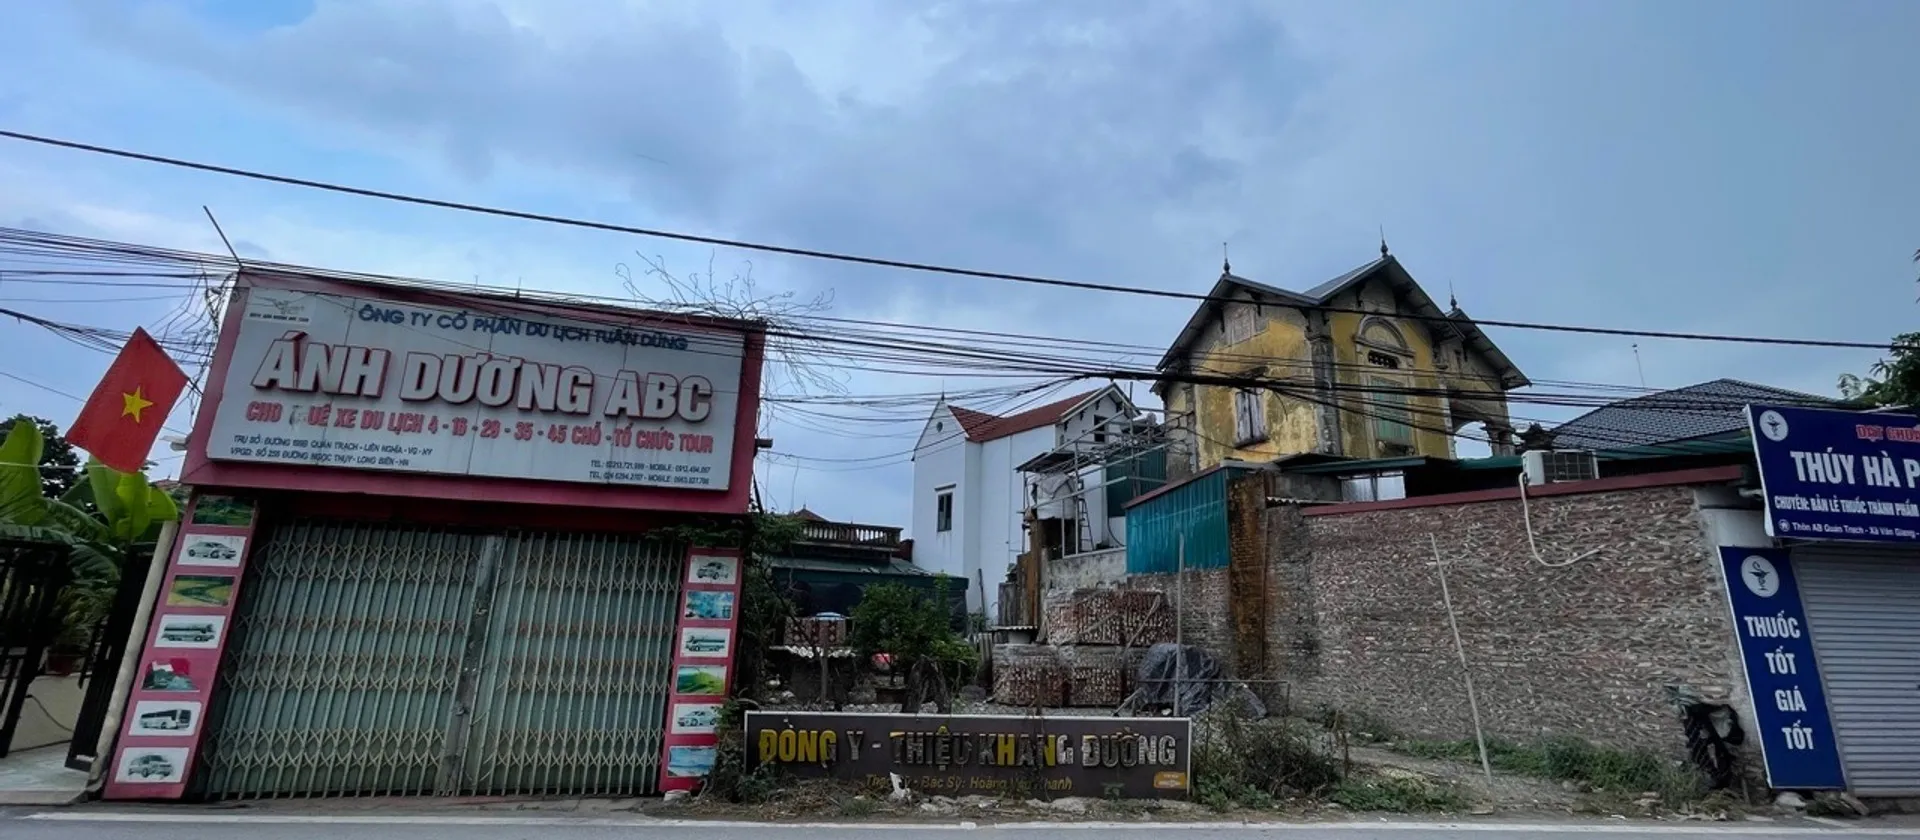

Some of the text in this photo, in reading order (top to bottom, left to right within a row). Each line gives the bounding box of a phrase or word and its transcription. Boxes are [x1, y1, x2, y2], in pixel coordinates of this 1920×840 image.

[411, 311, 433, 327] TY
[436, 310, 468, 330] CỔ
[526, 321, 549, 337] DU
[251, 329, 715, 424] ÁNH DƯƠNG ABC
[246, 400, 283, 422] CHO
[334, 407, 358, 428] XE
[360, 409, 385, 430] DU
[387, 411, 425, 435] LỊCH
[427, 415, 438, 434] 4
[451, 416, 469, 437] 16
[513, 421, 534, 441] 35
[547, 424, 567, 444] 45
[571, 421, 602, 446] CHỖ
[636, 426, 674, 450] CHỨC
[679, 433, 714, 453] TOUR
[1790, 447, 1855, 485] THÚY
[1862, 450, 1901, 488] HÀ
[1743, 610, 1801, 639] THUỐC
[1764, 645, 1797, 675] TỐT
[1774, 685, 1807, 712] GIÁ
[846, 730, 864, 760] Y
[889, 725, 973, 771] THIỆU
[978, 732, 1074, 767] KHANG
[1081, 726, 1176, 768] ĐƯỜNG
[1781, 719, 1814, 750] TỐT
